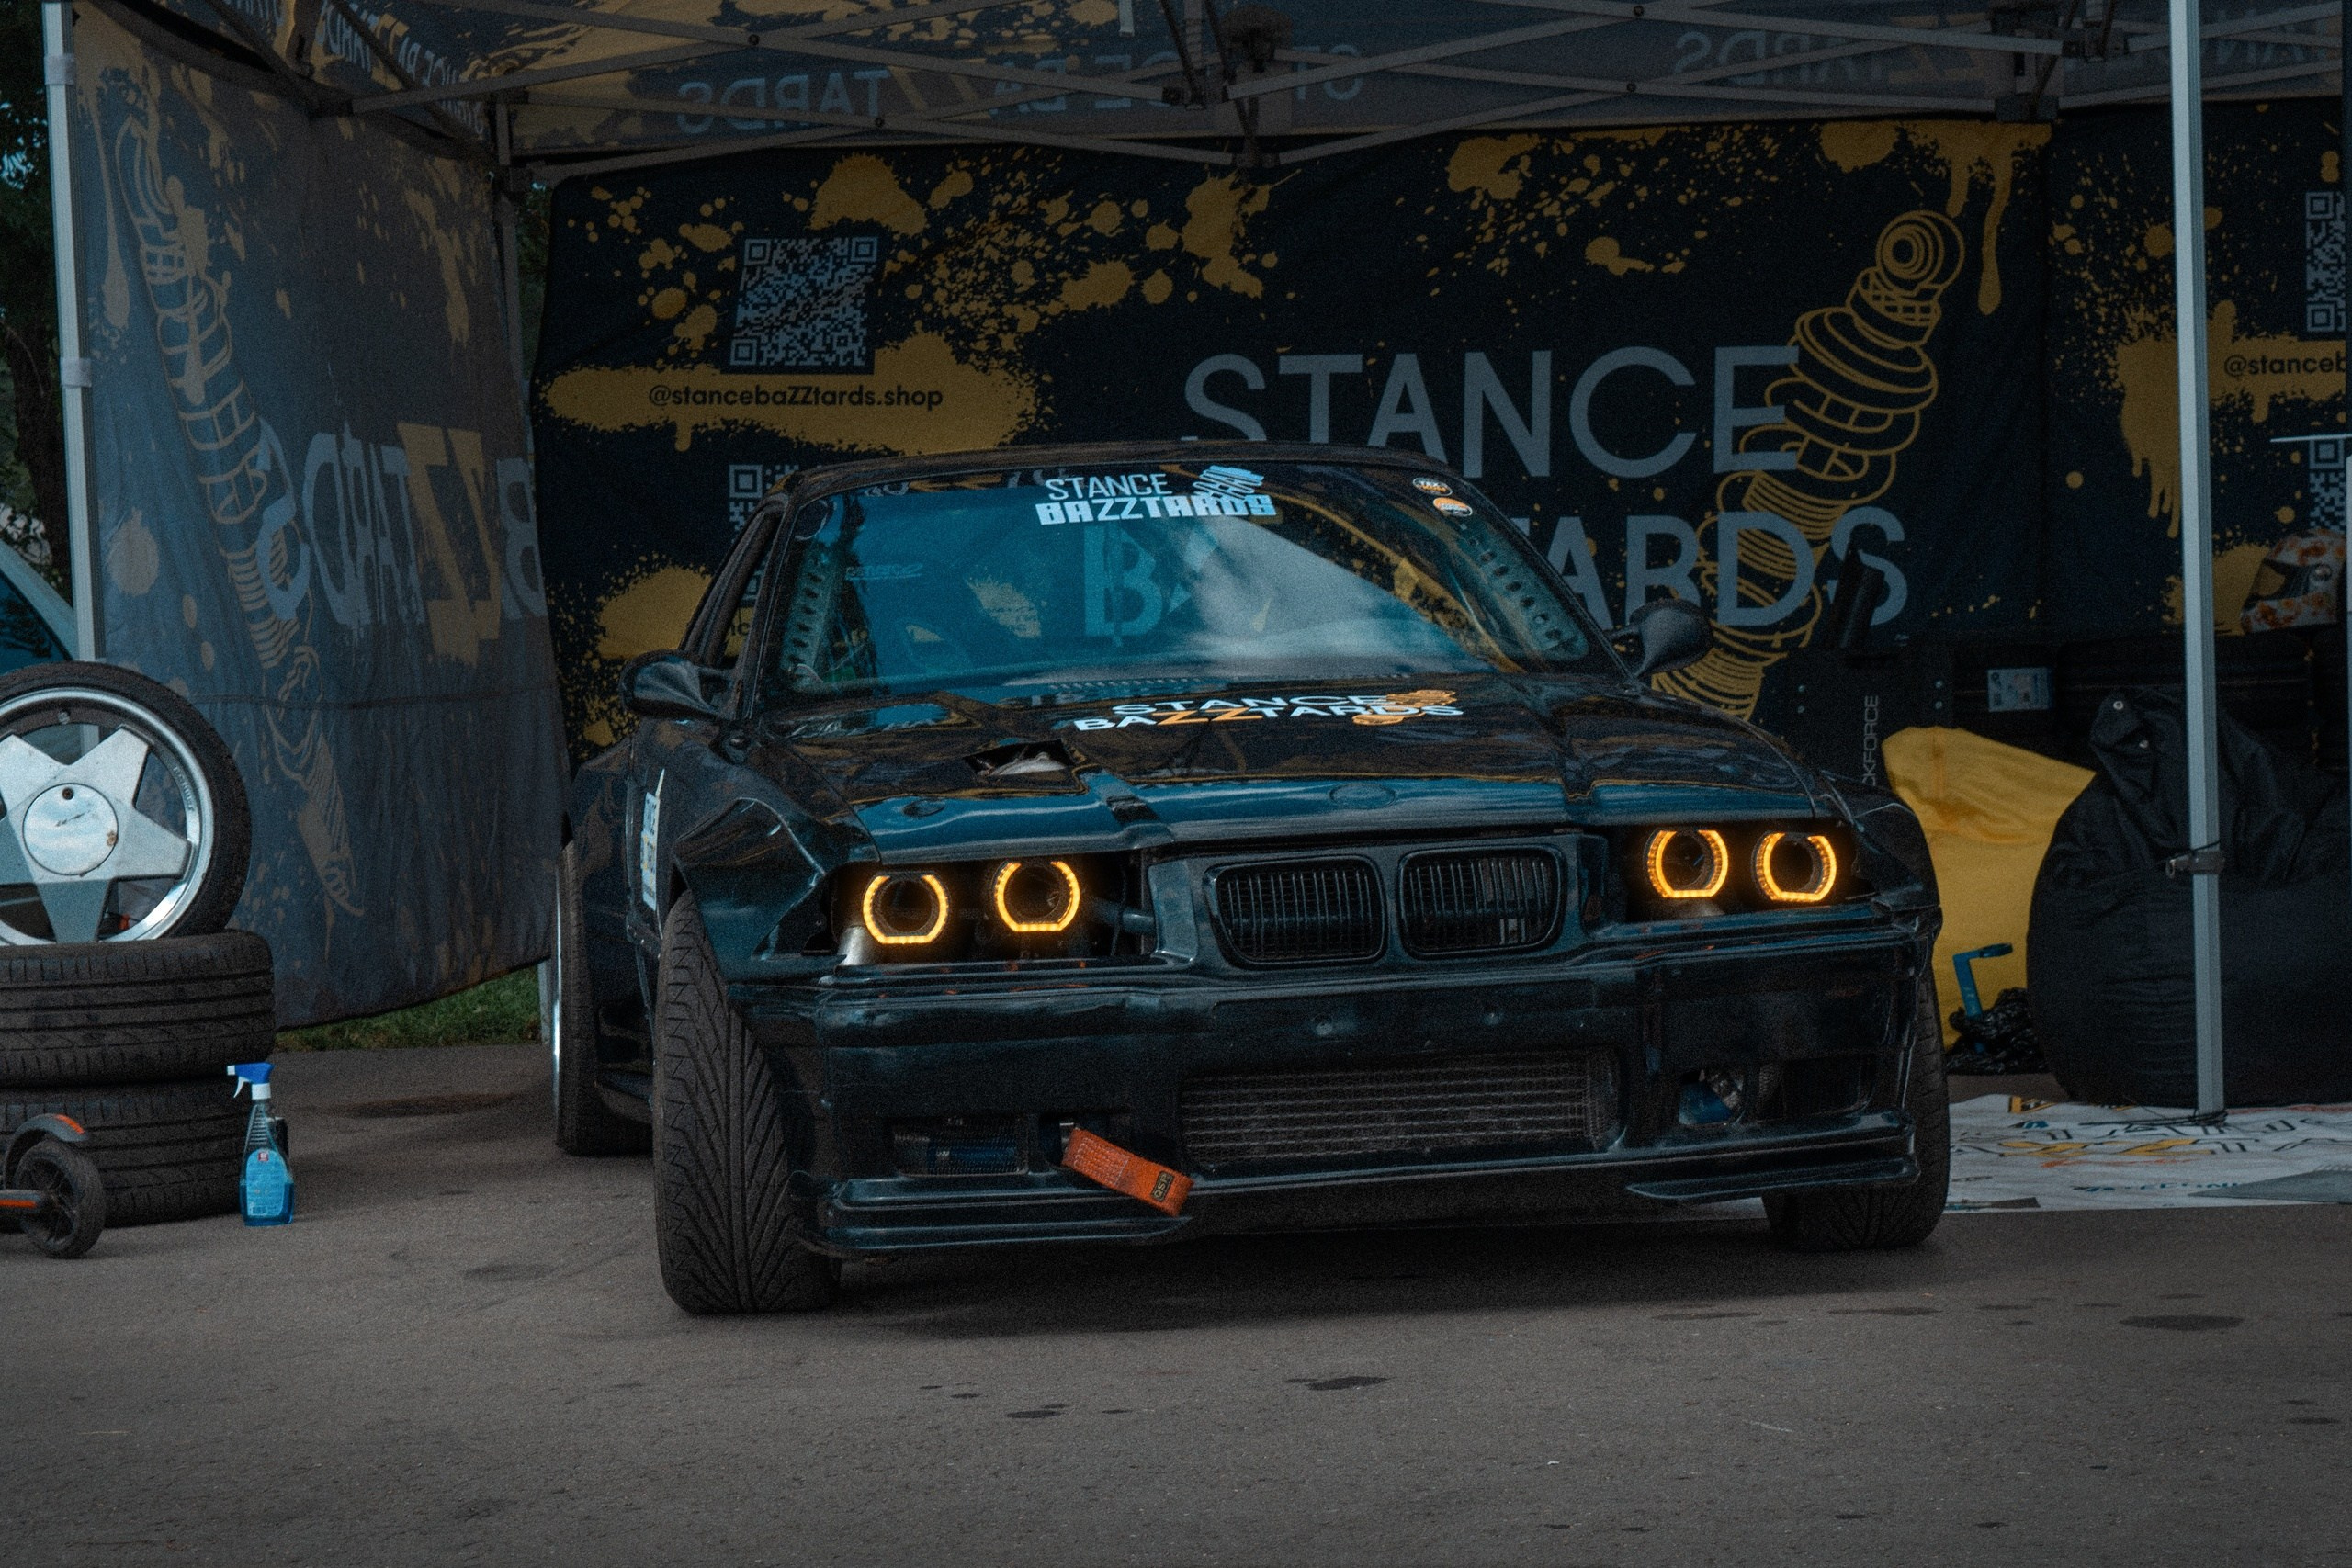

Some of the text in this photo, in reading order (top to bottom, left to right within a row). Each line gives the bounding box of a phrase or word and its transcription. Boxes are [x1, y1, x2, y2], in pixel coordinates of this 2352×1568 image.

[649, 384, 944, 411] @stancebaZZtards.shop
[1181, 344, 1800, 479] STANCE
[1045, 473, 1173, 501] STANCE
[1035, 494, 1277, 525] BAZZTARDS
[1073, 705, 1464, 731] BAZZTARDS
[1111, 694, 1389, 716] STANCE
